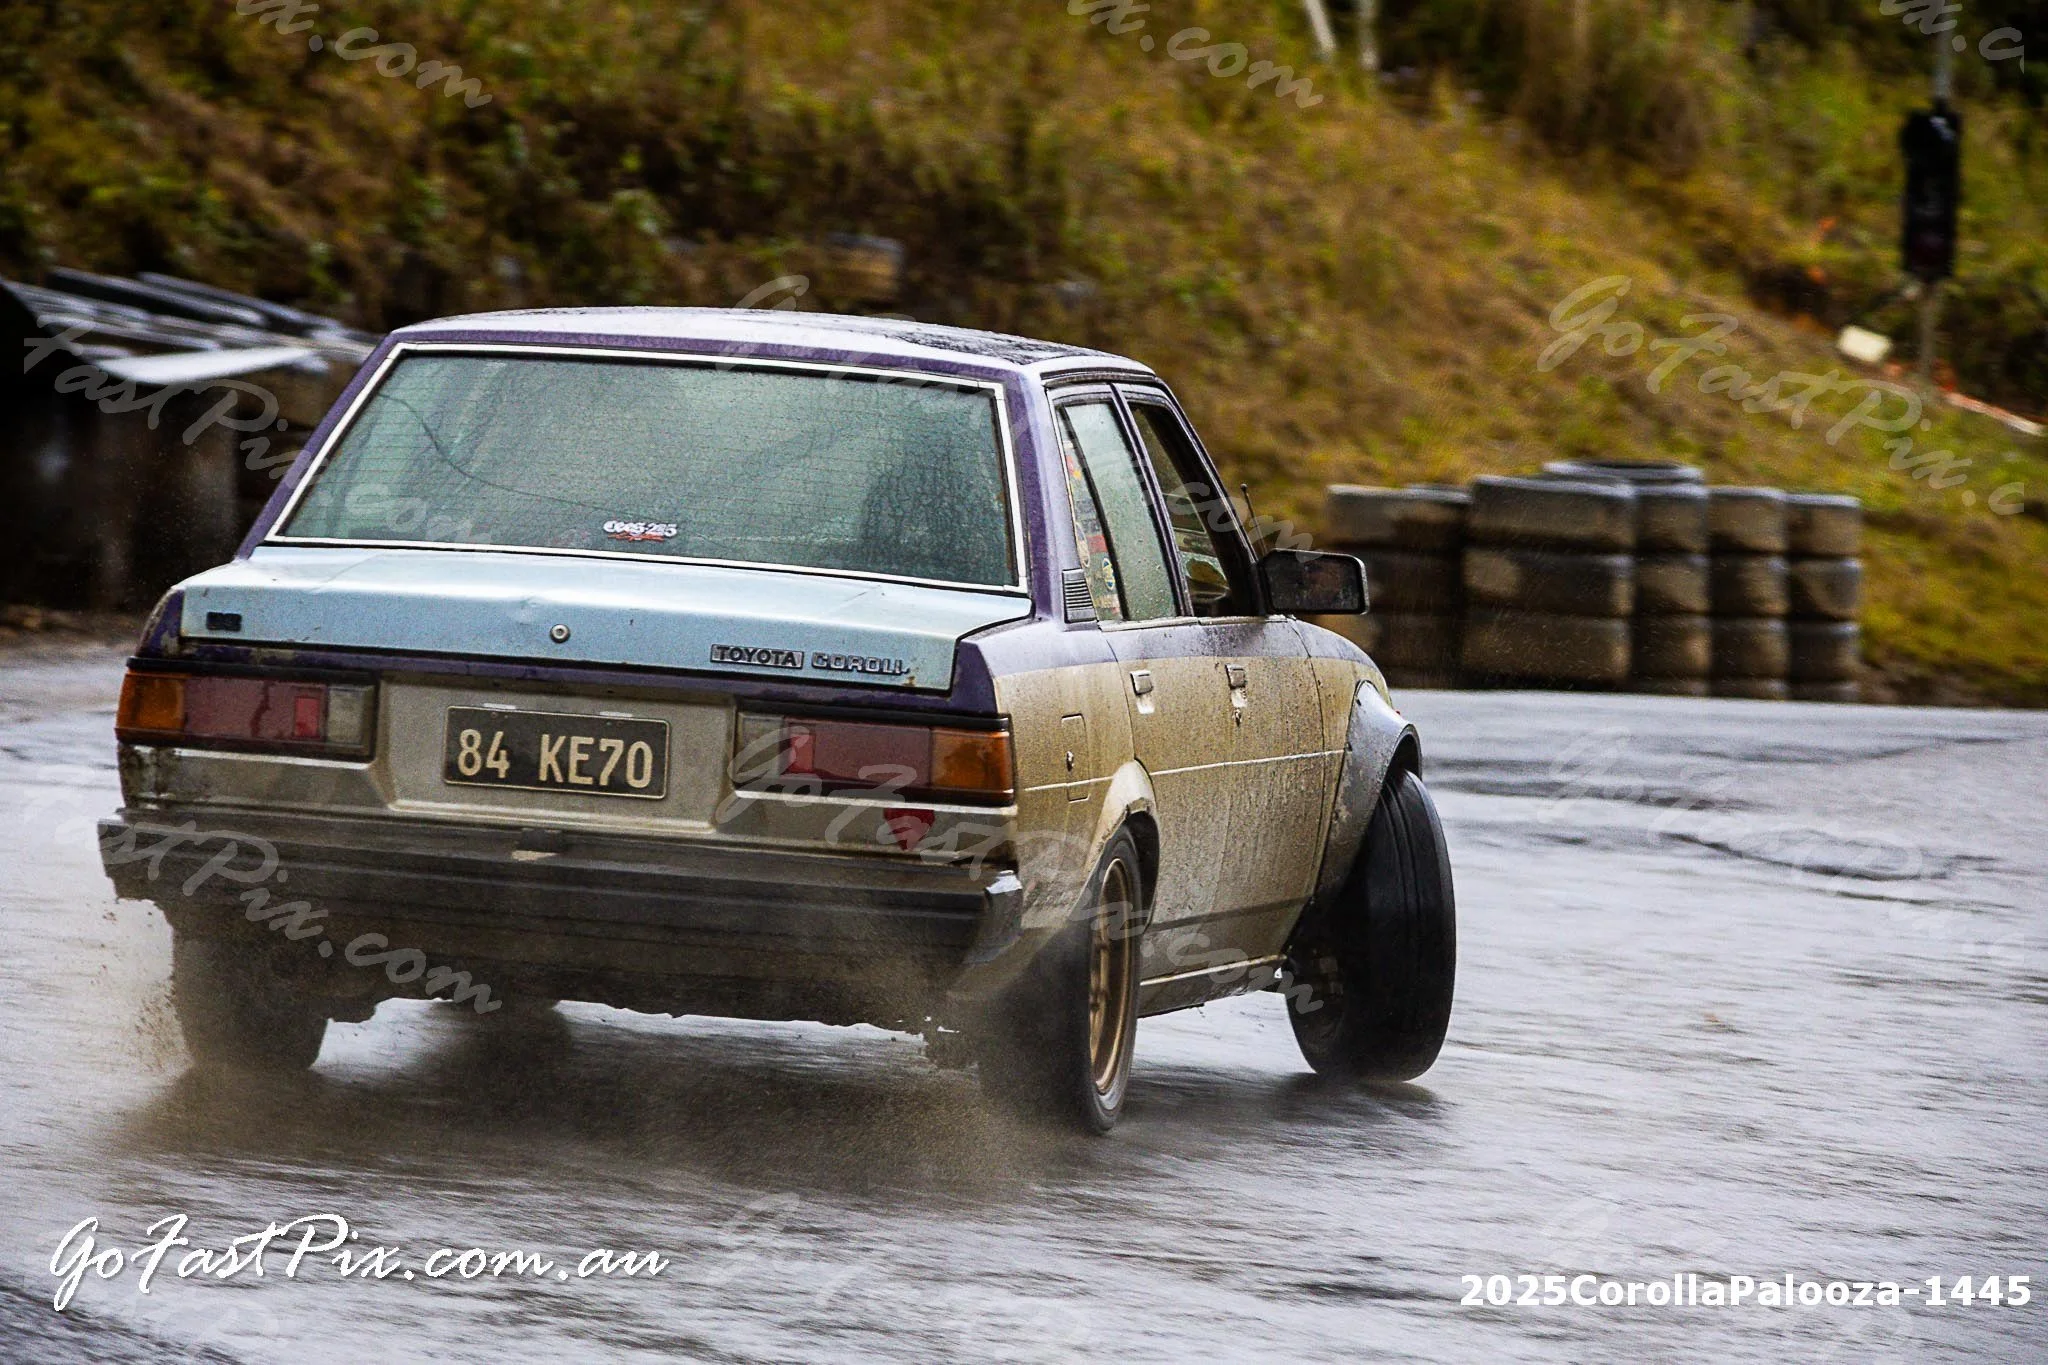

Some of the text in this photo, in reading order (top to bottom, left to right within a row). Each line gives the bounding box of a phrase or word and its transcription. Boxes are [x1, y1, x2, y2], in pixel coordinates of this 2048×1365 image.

[716, 645, 798, 668] TOYOTA
[458, 728, 654, 789] 84 KE70
